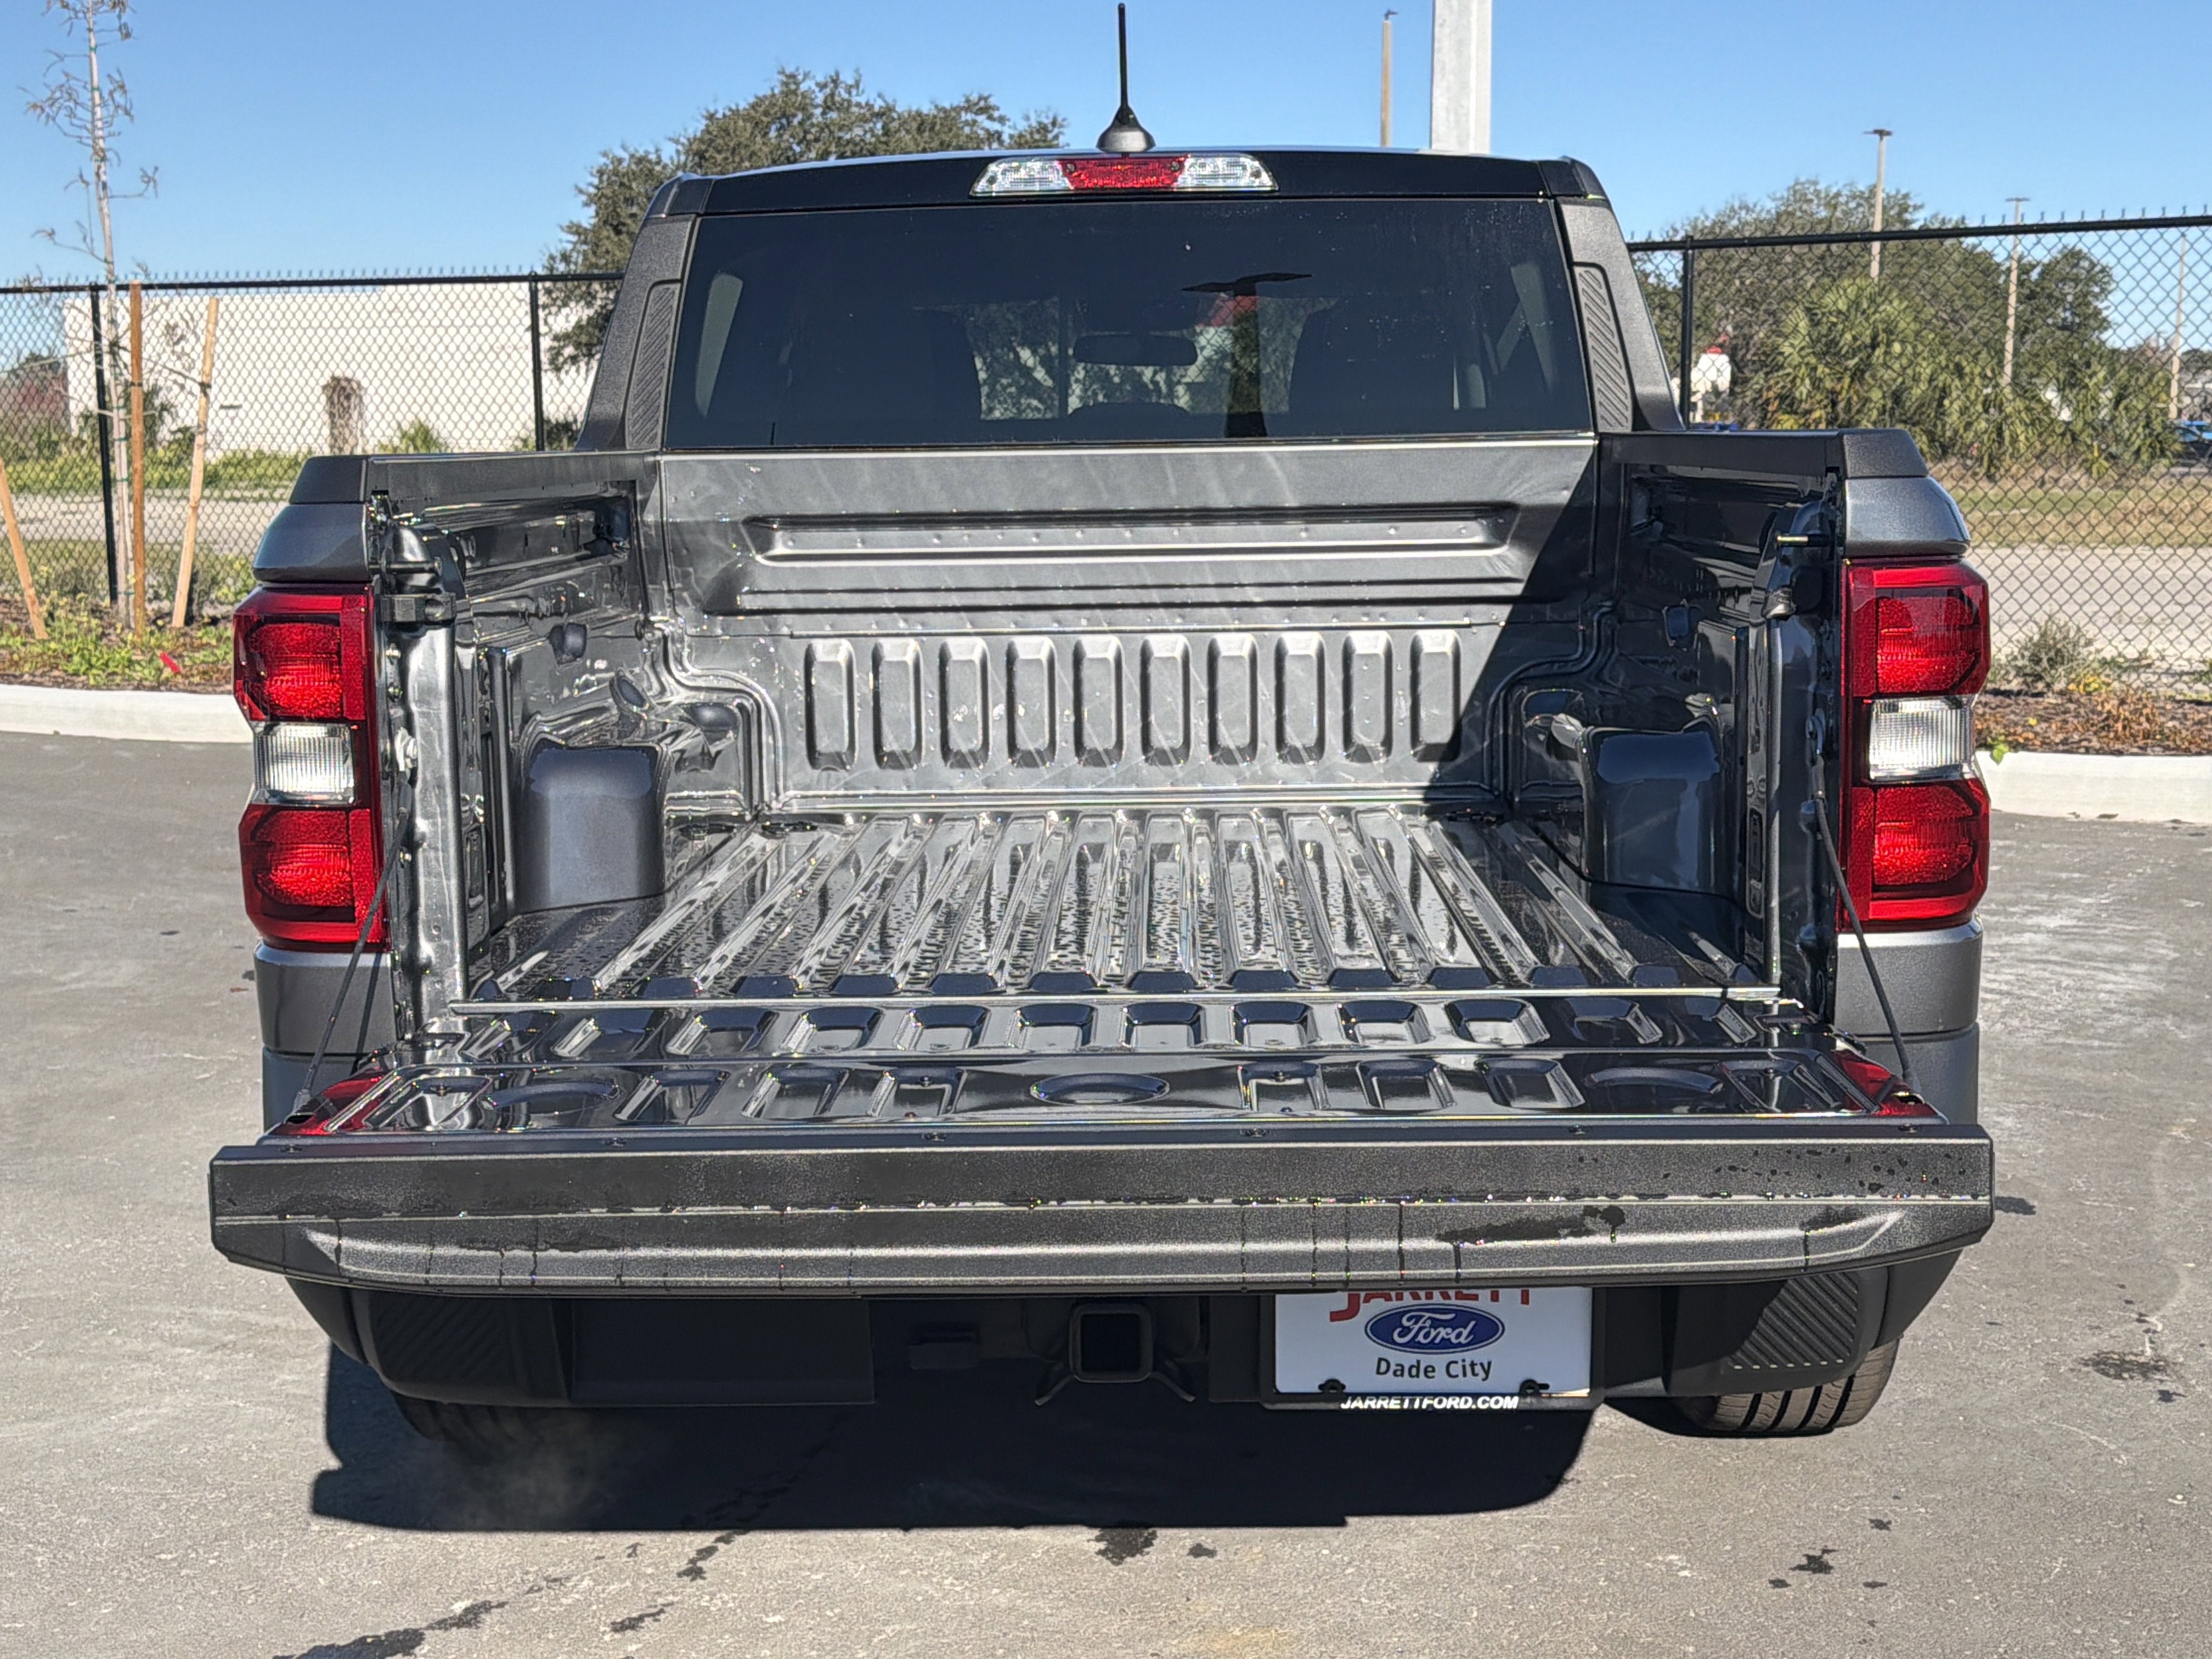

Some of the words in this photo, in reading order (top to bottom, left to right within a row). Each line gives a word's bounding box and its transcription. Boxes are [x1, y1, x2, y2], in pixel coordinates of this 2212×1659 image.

[1392, 1311, 1477, 1344] Ford
[1375, 1357, 1436, 1379] Dade
[1445, 1358, 1492, 1382] City
[1340, 1396, 1519, 1409] JARRETTFORD.COM
